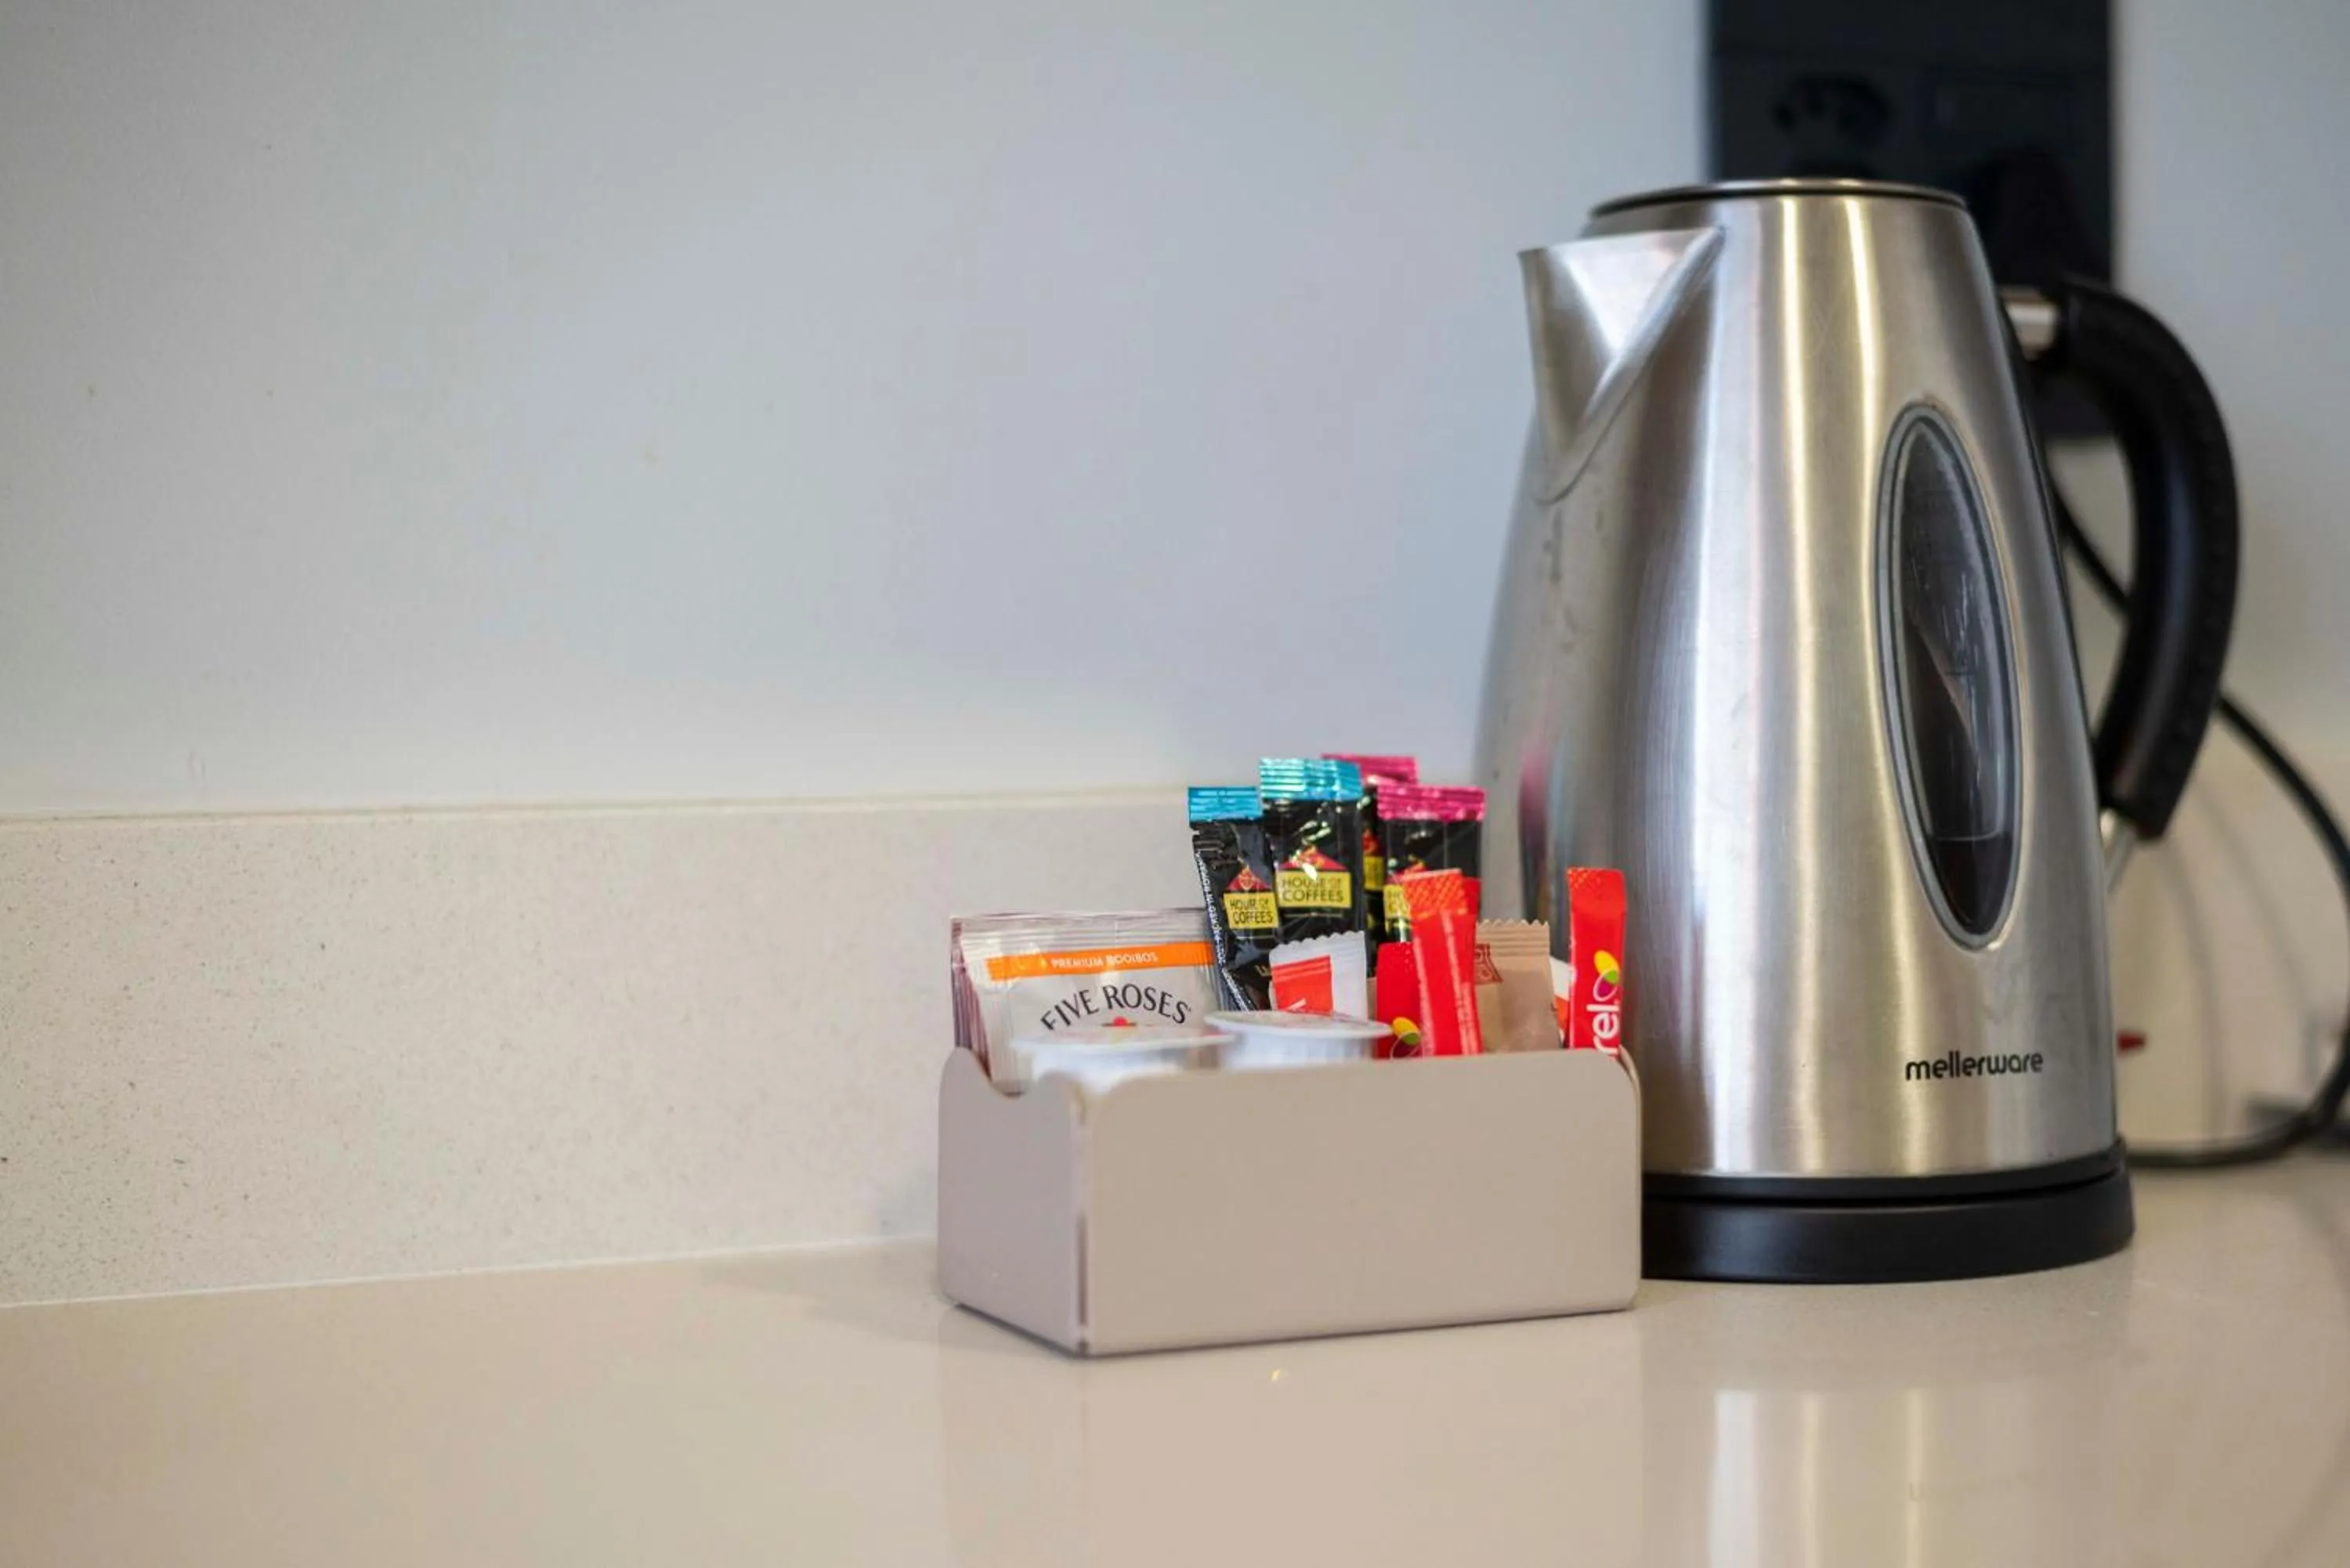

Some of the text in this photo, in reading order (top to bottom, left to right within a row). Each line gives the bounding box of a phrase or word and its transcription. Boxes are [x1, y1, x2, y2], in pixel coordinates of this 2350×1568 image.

[1282, 889, 1344, 902] COFFEES
[1232, 910, 1274, 925] COFFEES
[1050, 951, 1159, 969] PREMIUM ROOIBOS
[1040, 988, 1099, 1031] FIVE
[1101, 982, 1188, 1024] ROSES
[1905, 1050, 2044, 1080] mellerware
